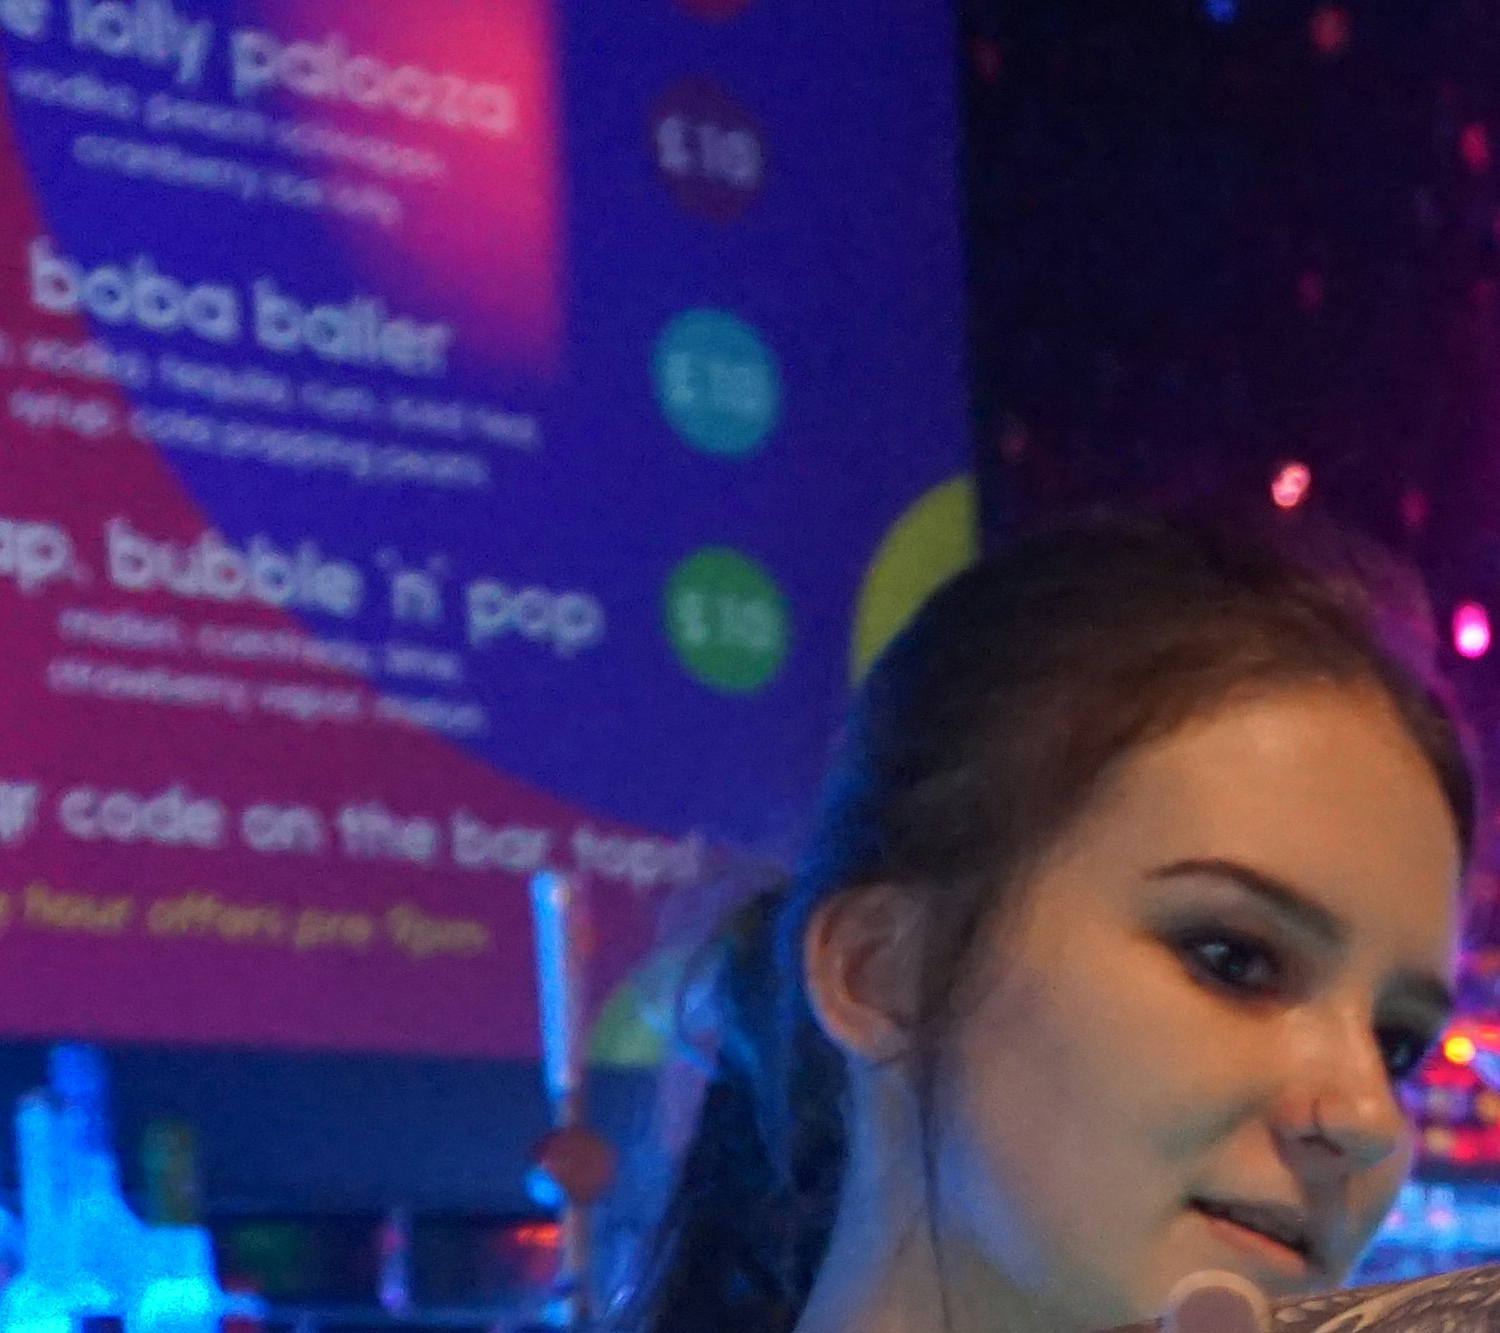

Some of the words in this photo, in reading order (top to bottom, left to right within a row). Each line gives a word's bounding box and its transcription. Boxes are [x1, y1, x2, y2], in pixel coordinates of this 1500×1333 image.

[230, 30, 517, 138] palooza
[29, 235, 241, 344] boba
[253, 276, 455, 377] baller
[105, 516, 364, 620] bubble
[464, 576, 602, 657] pop
[57, 777, 227, 848] code
[241, 803, 324, 854] on
[336, 801, 441, 867] the
[449, 808, 551, 873] bar
[24, 881, 135, 932] hour
